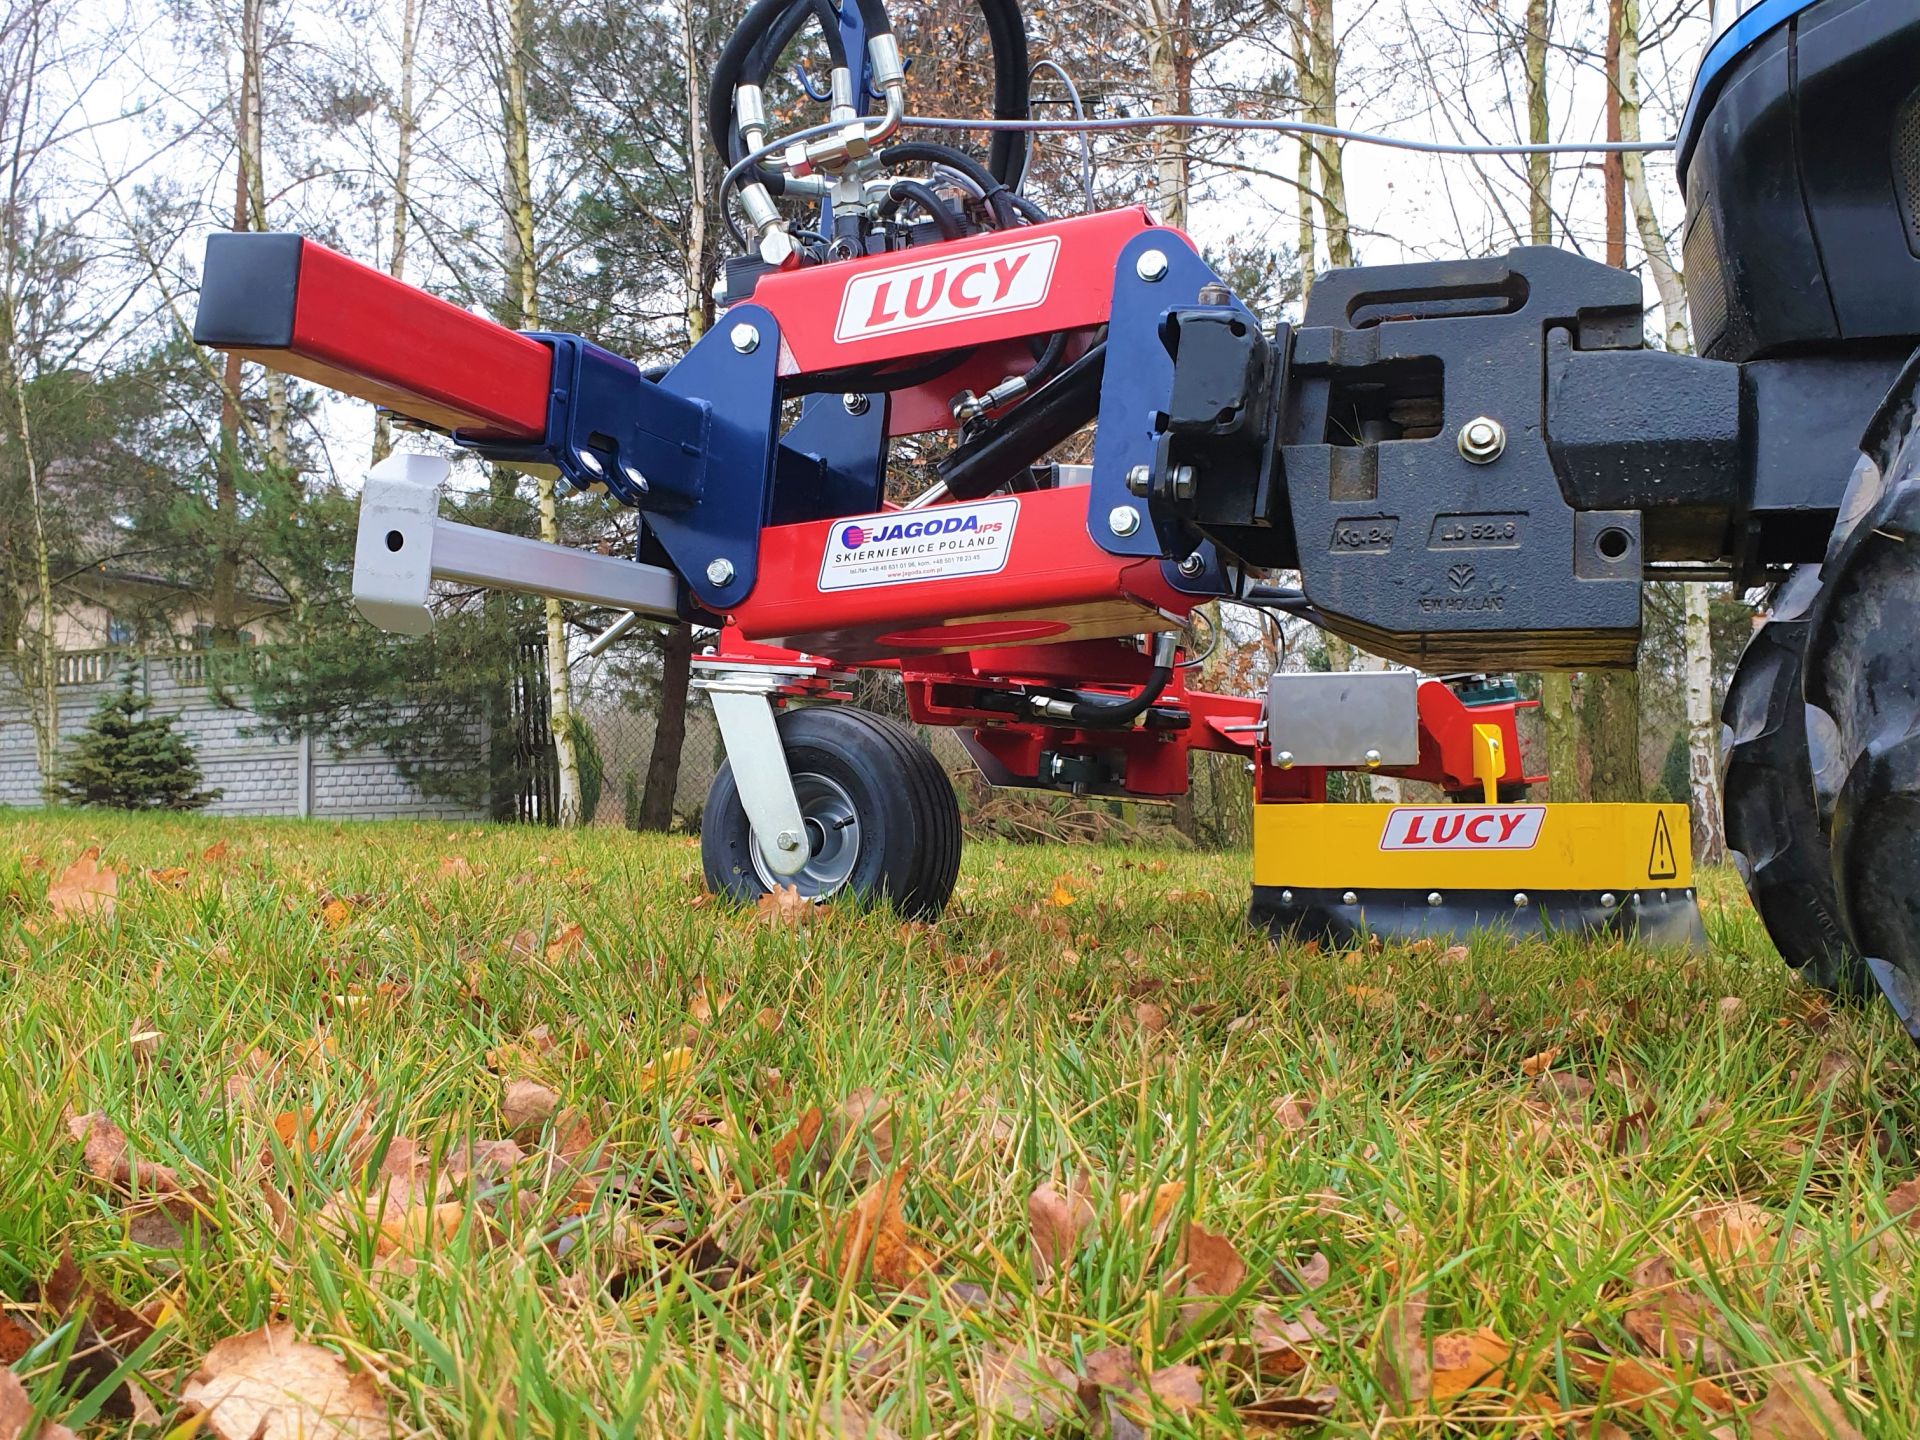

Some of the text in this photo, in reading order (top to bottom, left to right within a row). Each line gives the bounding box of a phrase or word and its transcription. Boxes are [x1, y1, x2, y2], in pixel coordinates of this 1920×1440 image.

[865, 253, 1031, 328] LUCY
[872, 515, 1002, 542] JAGODA JPS
[1441, 523, 1466, 541] Lb
[835, 536, 995, 563] SKIERNIEWICE POLAND
[1445, 596, 1505, 613] HOLLAND
[1402, 813, 1527, 845] LUCY
